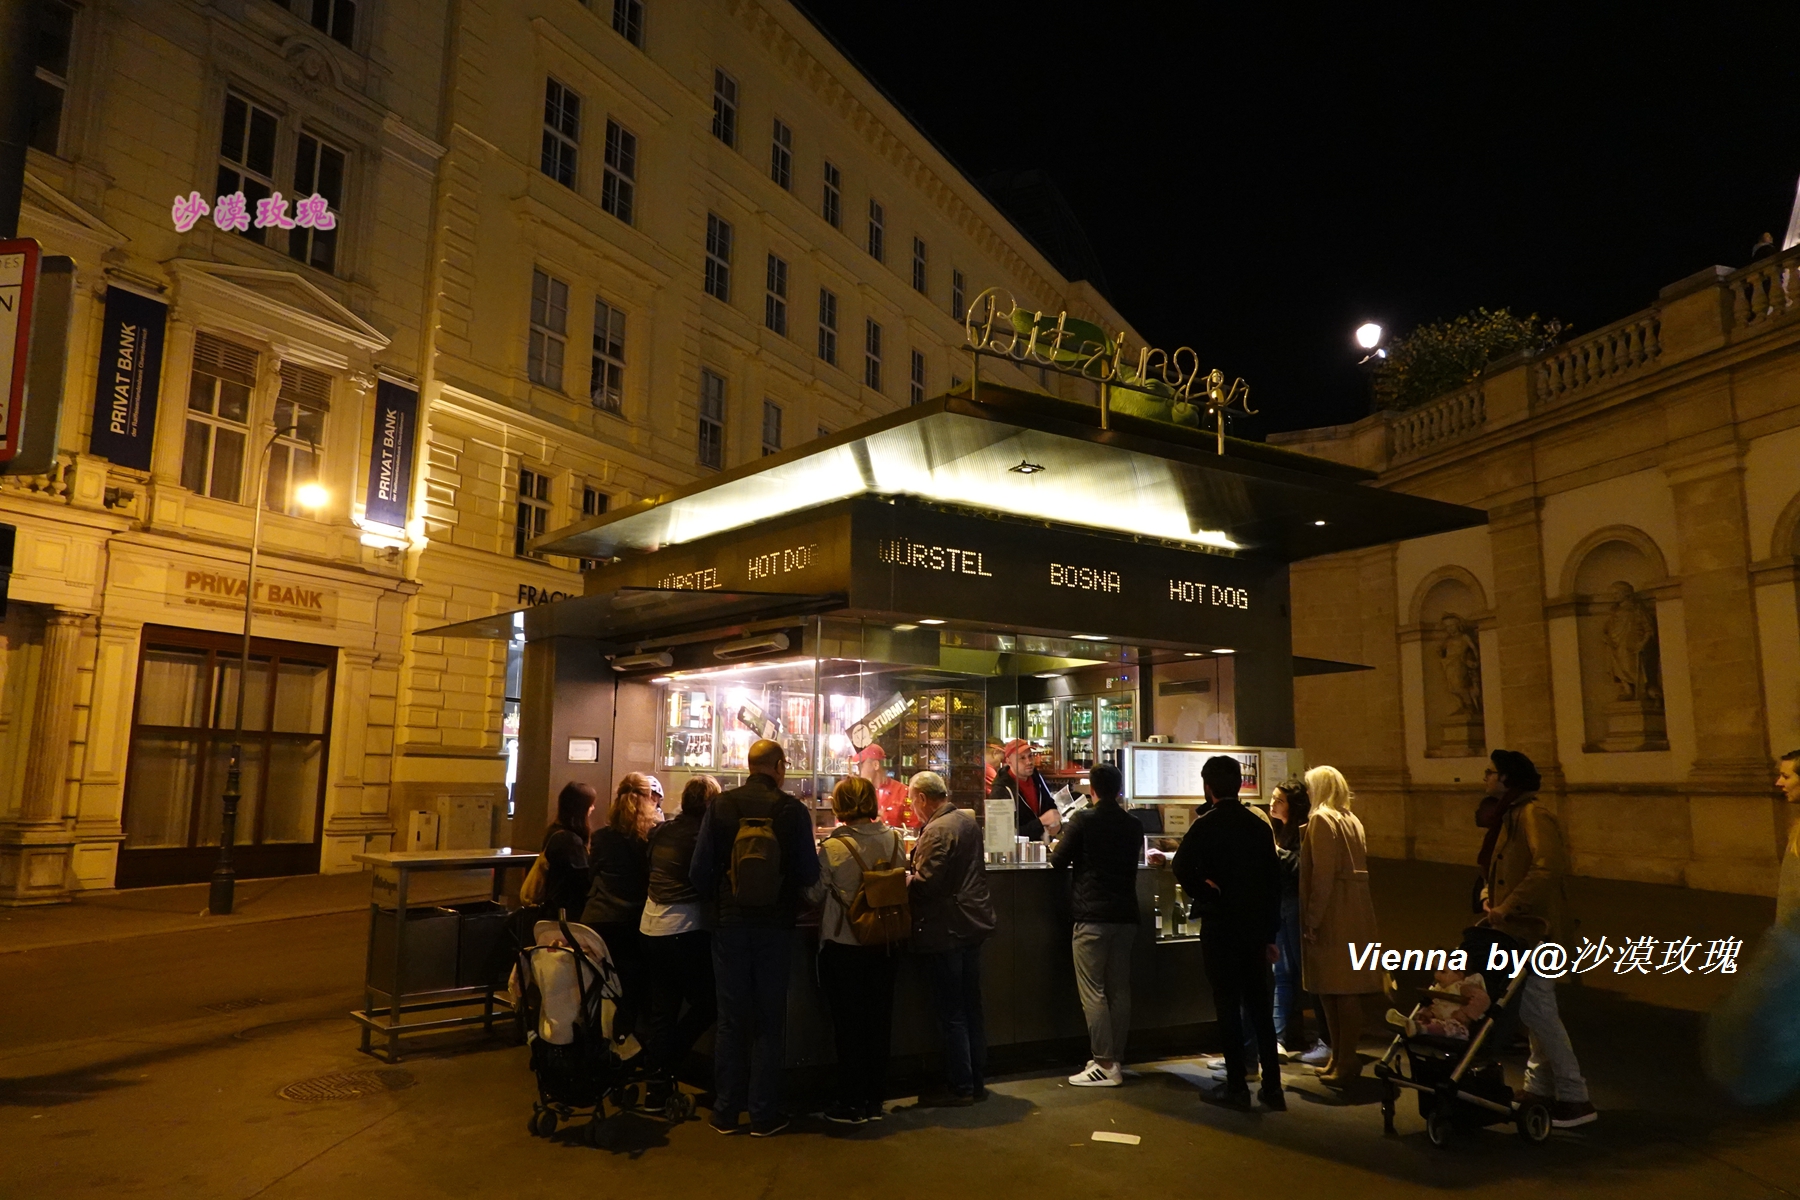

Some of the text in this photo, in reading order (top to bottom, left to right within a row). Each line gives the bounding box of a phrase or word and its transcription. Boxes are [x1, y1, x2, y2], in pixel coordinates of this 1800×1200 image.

[0, 257, 19, 269] ES
[110, 321, 137, 435] PRIVAT BANK
[378, 408, 397, 501] PRIVAT BANK
[748, 551, 780, 580] HOT
[784, 543, 819, 572] DOG
[879, 537, 1248, 609] WÜRSTEL BOSNA HOT DOG
[184, 571, 322, 609] PRIVAT BANK
